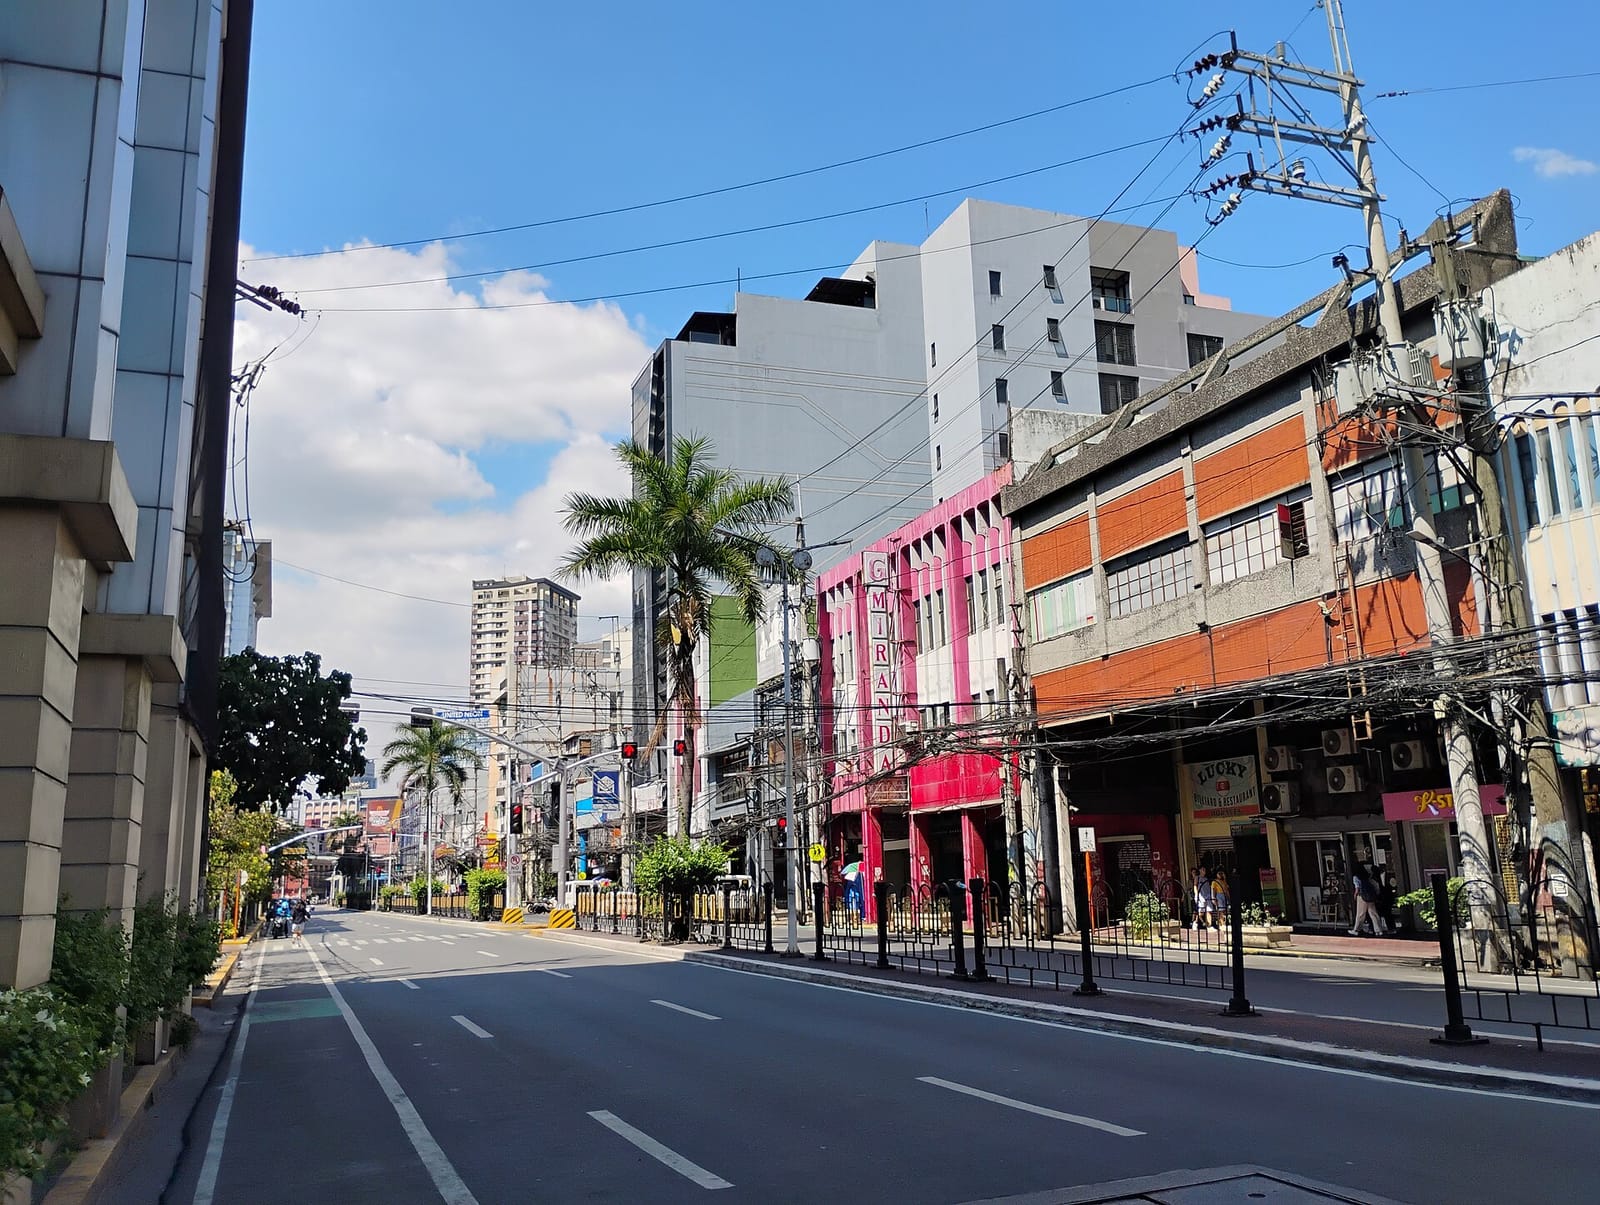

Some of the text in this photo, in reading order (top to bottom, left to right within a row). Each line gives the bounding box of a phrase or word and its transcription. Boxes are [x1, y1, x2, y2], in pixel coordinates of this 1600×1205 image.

[872, 591, 891, 770] MIRANDA
[1197, 760, 1247, 785] LUCKY
[1223, 786, 1256, 807] RESTAURANT
